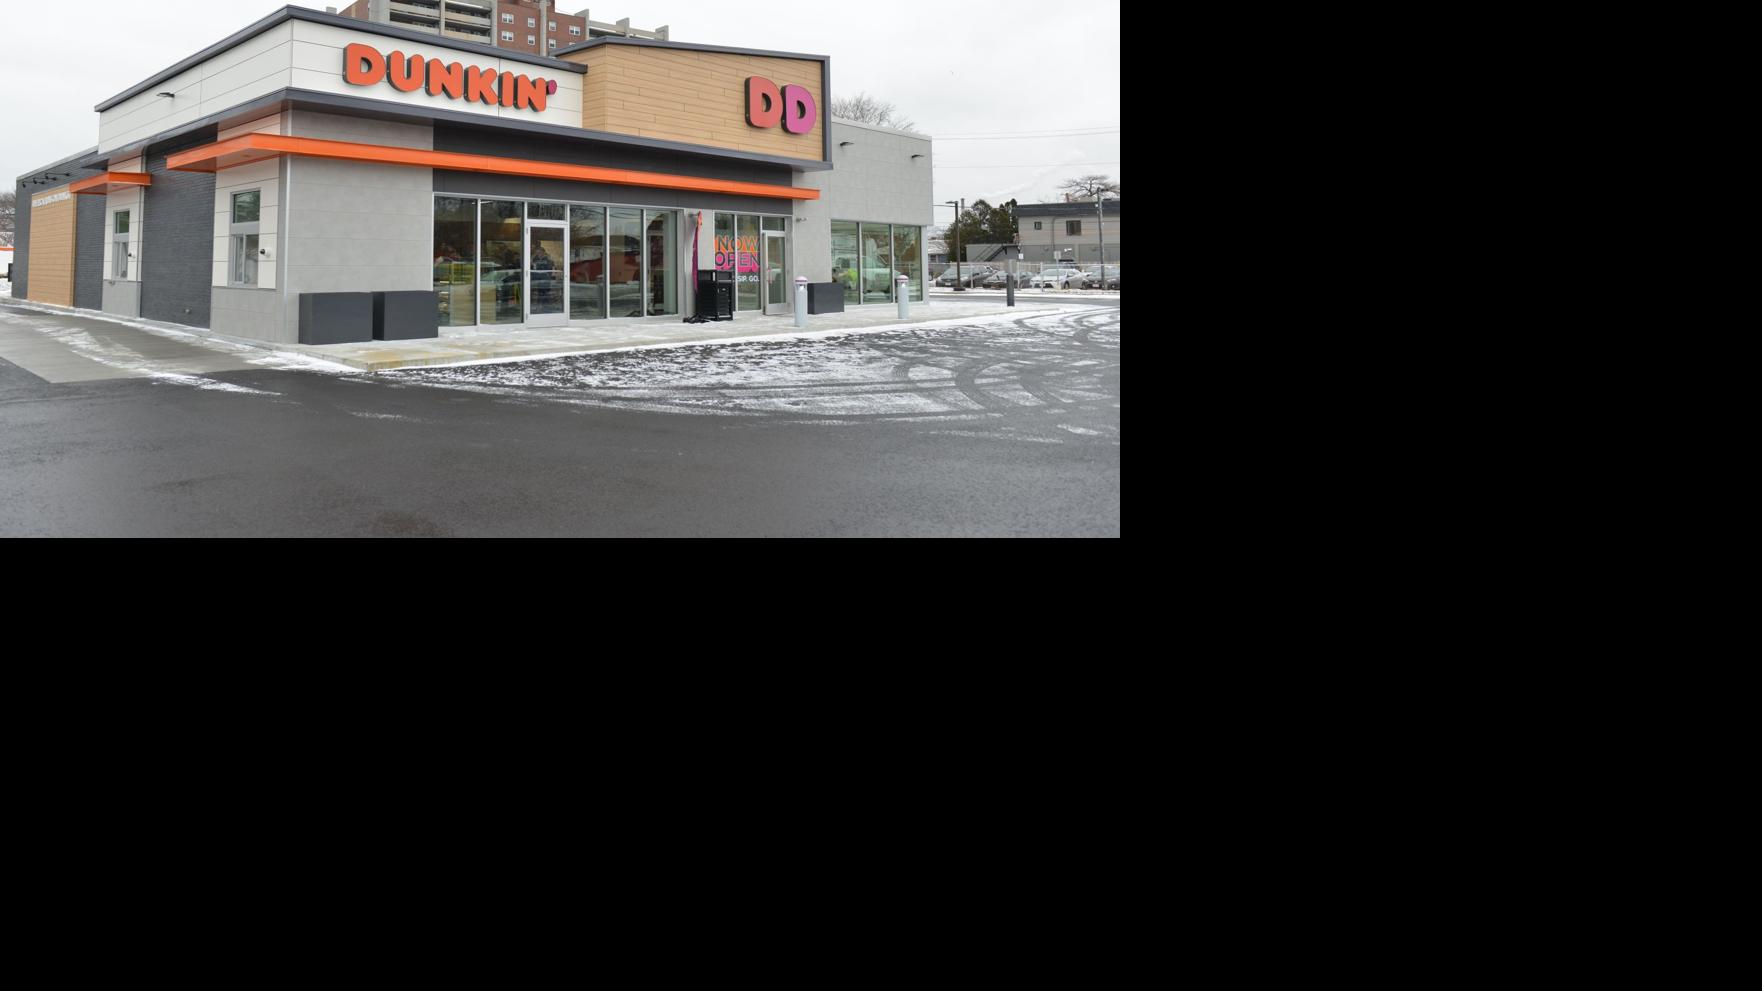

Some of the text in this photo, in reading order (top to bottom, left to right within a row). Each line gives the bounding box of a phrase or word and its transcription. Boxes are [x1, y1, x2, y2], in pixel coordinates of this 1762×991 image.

[343, 42, 557, 113] DUNKIN'
[745, 75, 817, 134] DD
[715, 251, 760, 267] OPEN
[717, 236, 760, 251] NOW
